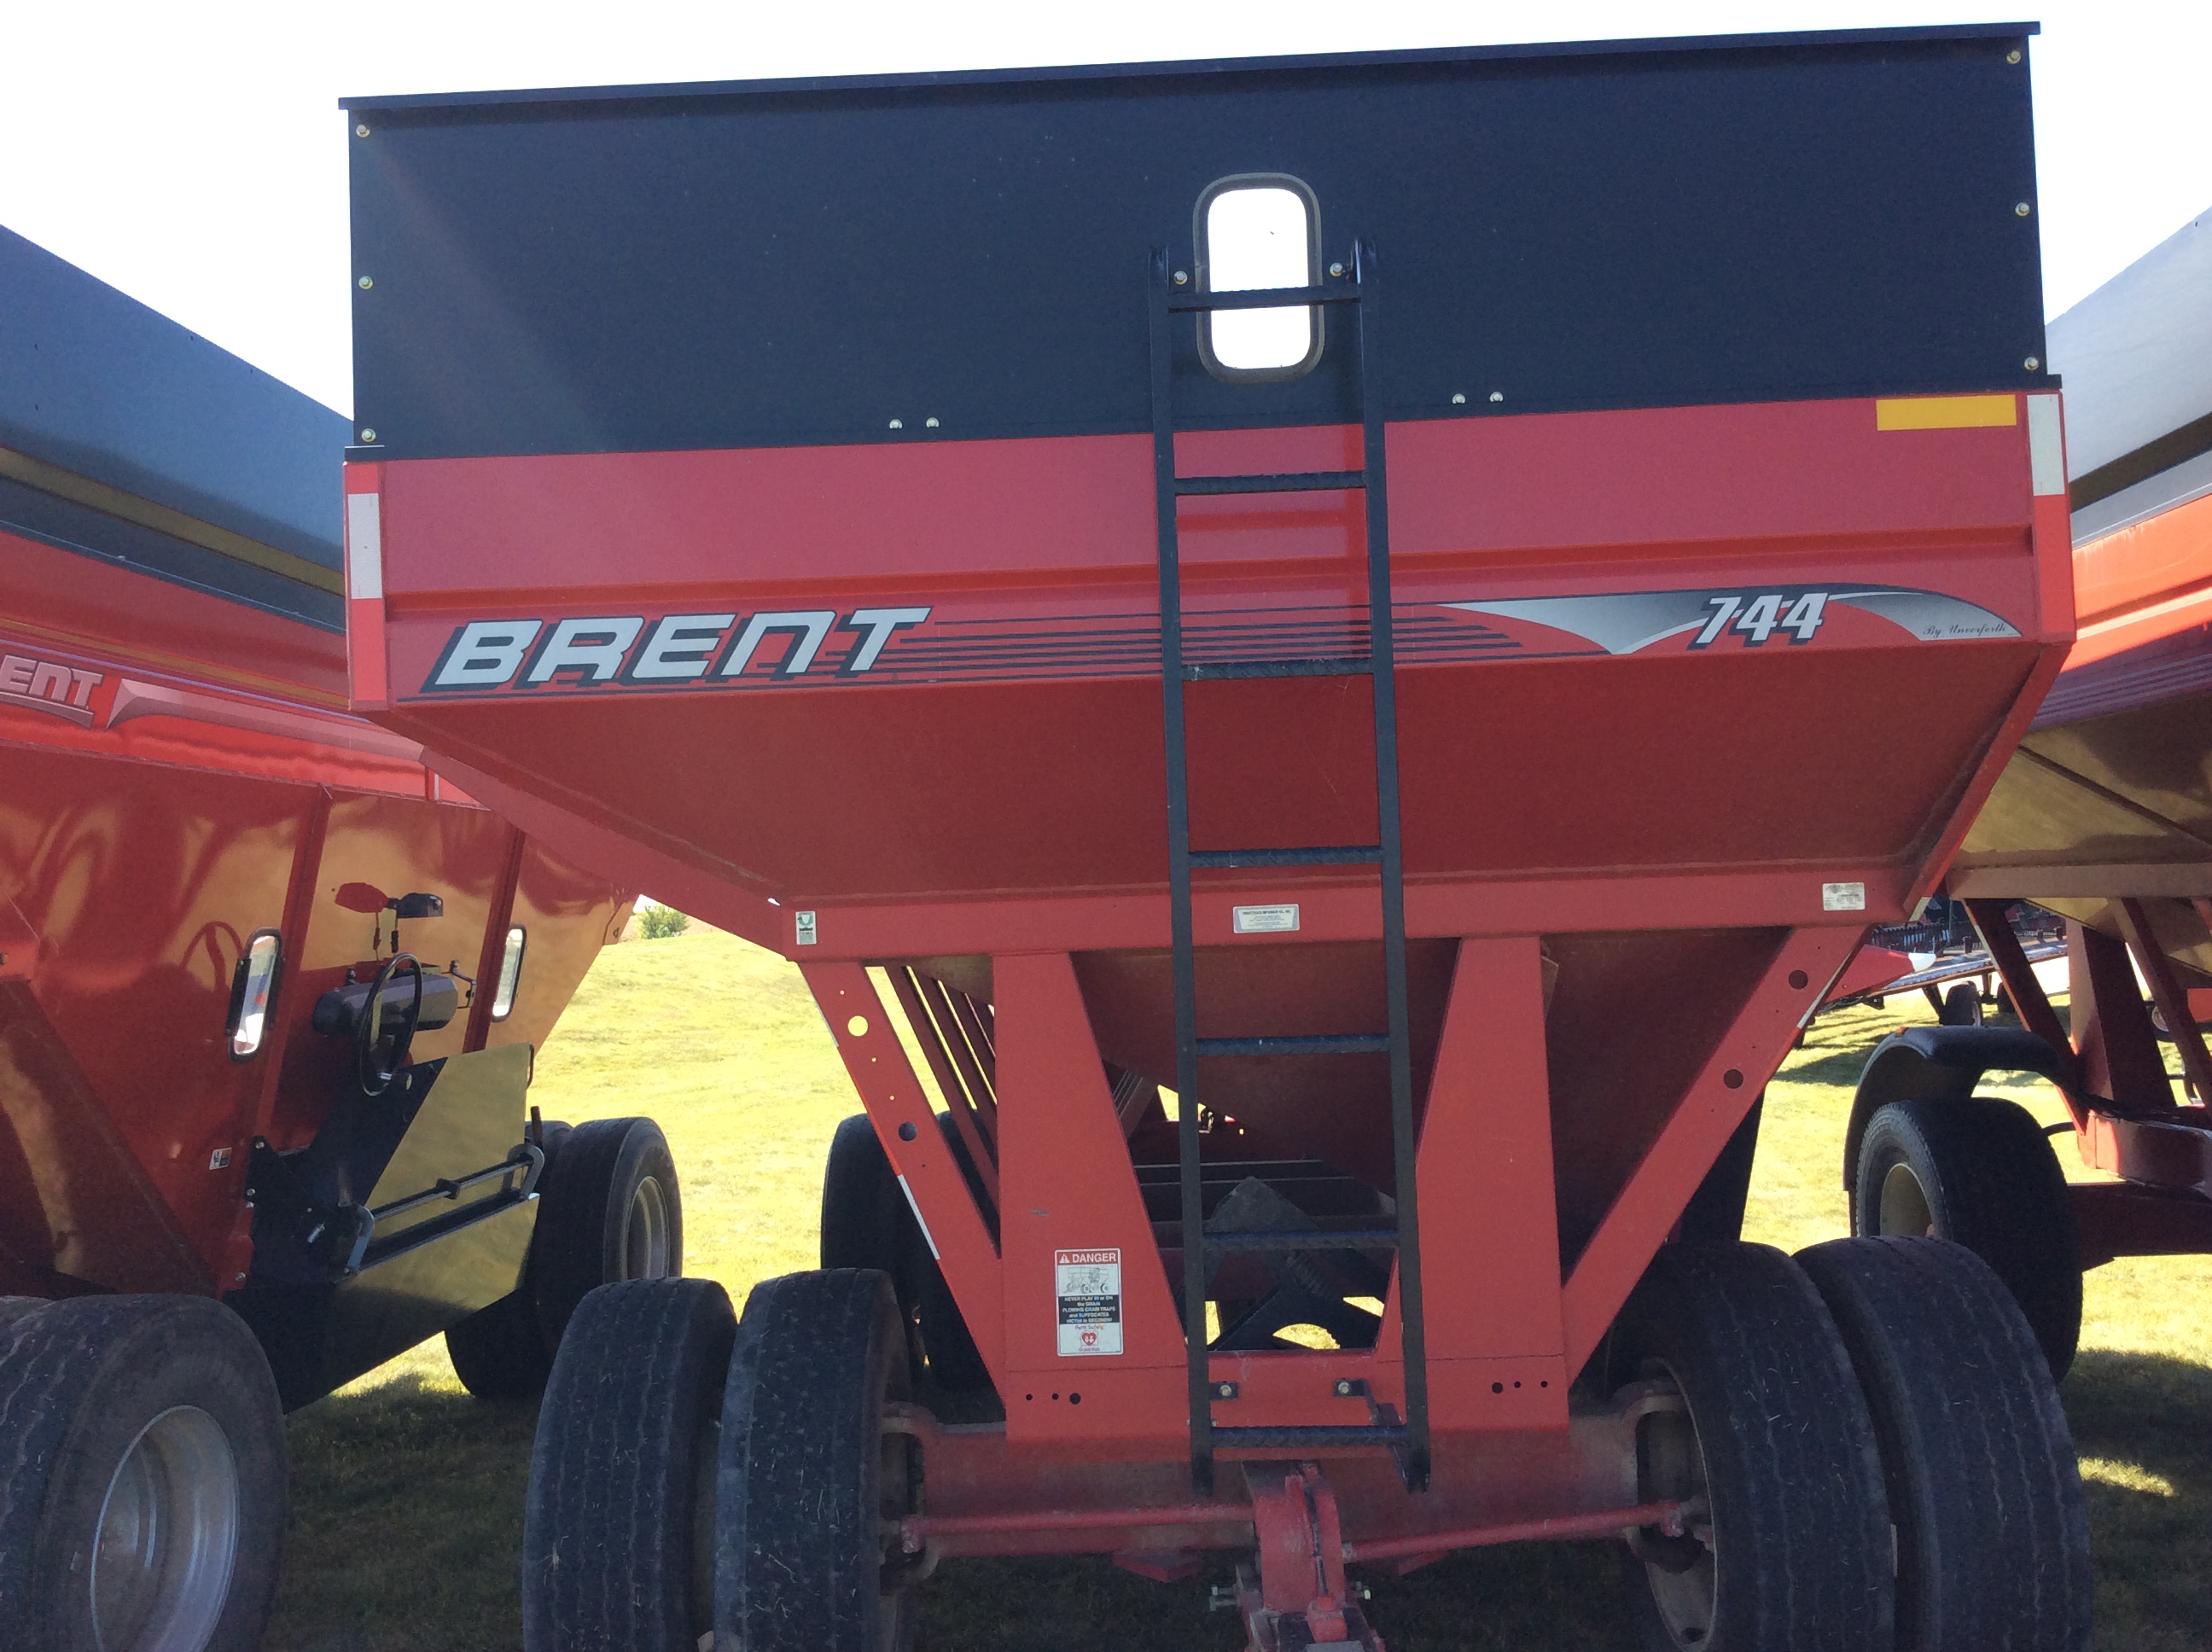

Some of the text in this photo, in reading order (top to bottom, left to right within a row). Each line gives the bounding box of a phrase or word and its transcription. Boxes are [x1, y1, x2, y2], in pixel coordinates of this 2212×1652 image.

[1693, 592, 1829, 646] 744
[1922, 625, 1941, 638] By
[428, 606, 932, 687] BRENT
[1072, 1253, 1116, 1263] DANGER
